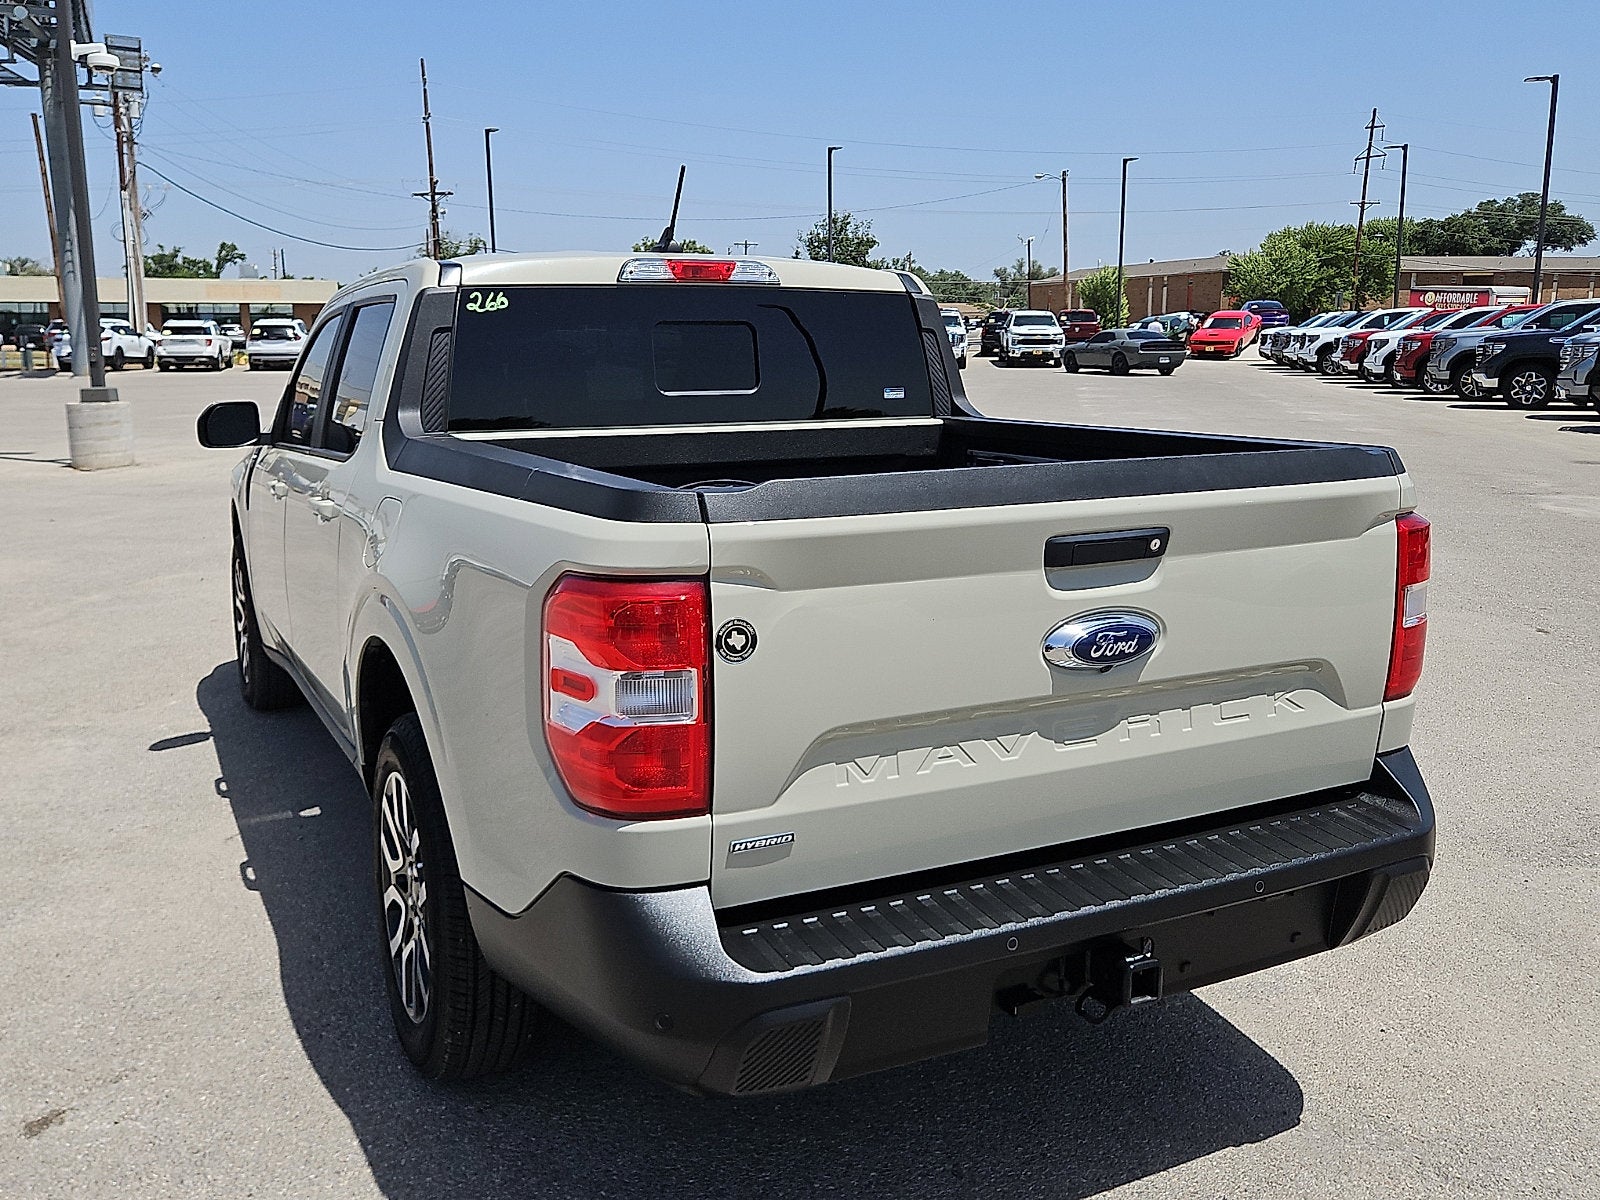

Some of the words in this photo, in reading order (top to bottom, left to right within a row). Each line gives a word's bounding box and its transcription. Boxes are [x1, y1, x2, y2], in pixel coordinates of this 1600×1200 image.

[466, 291, 509, 312] 266
[1434, 292, 1479, 304] AFFORDABLE
[1091, 630, 1139, 658] Ford
[834, 691, 1306, 787] MAVERICK
[734, 835, 793, 851] HYBRID
